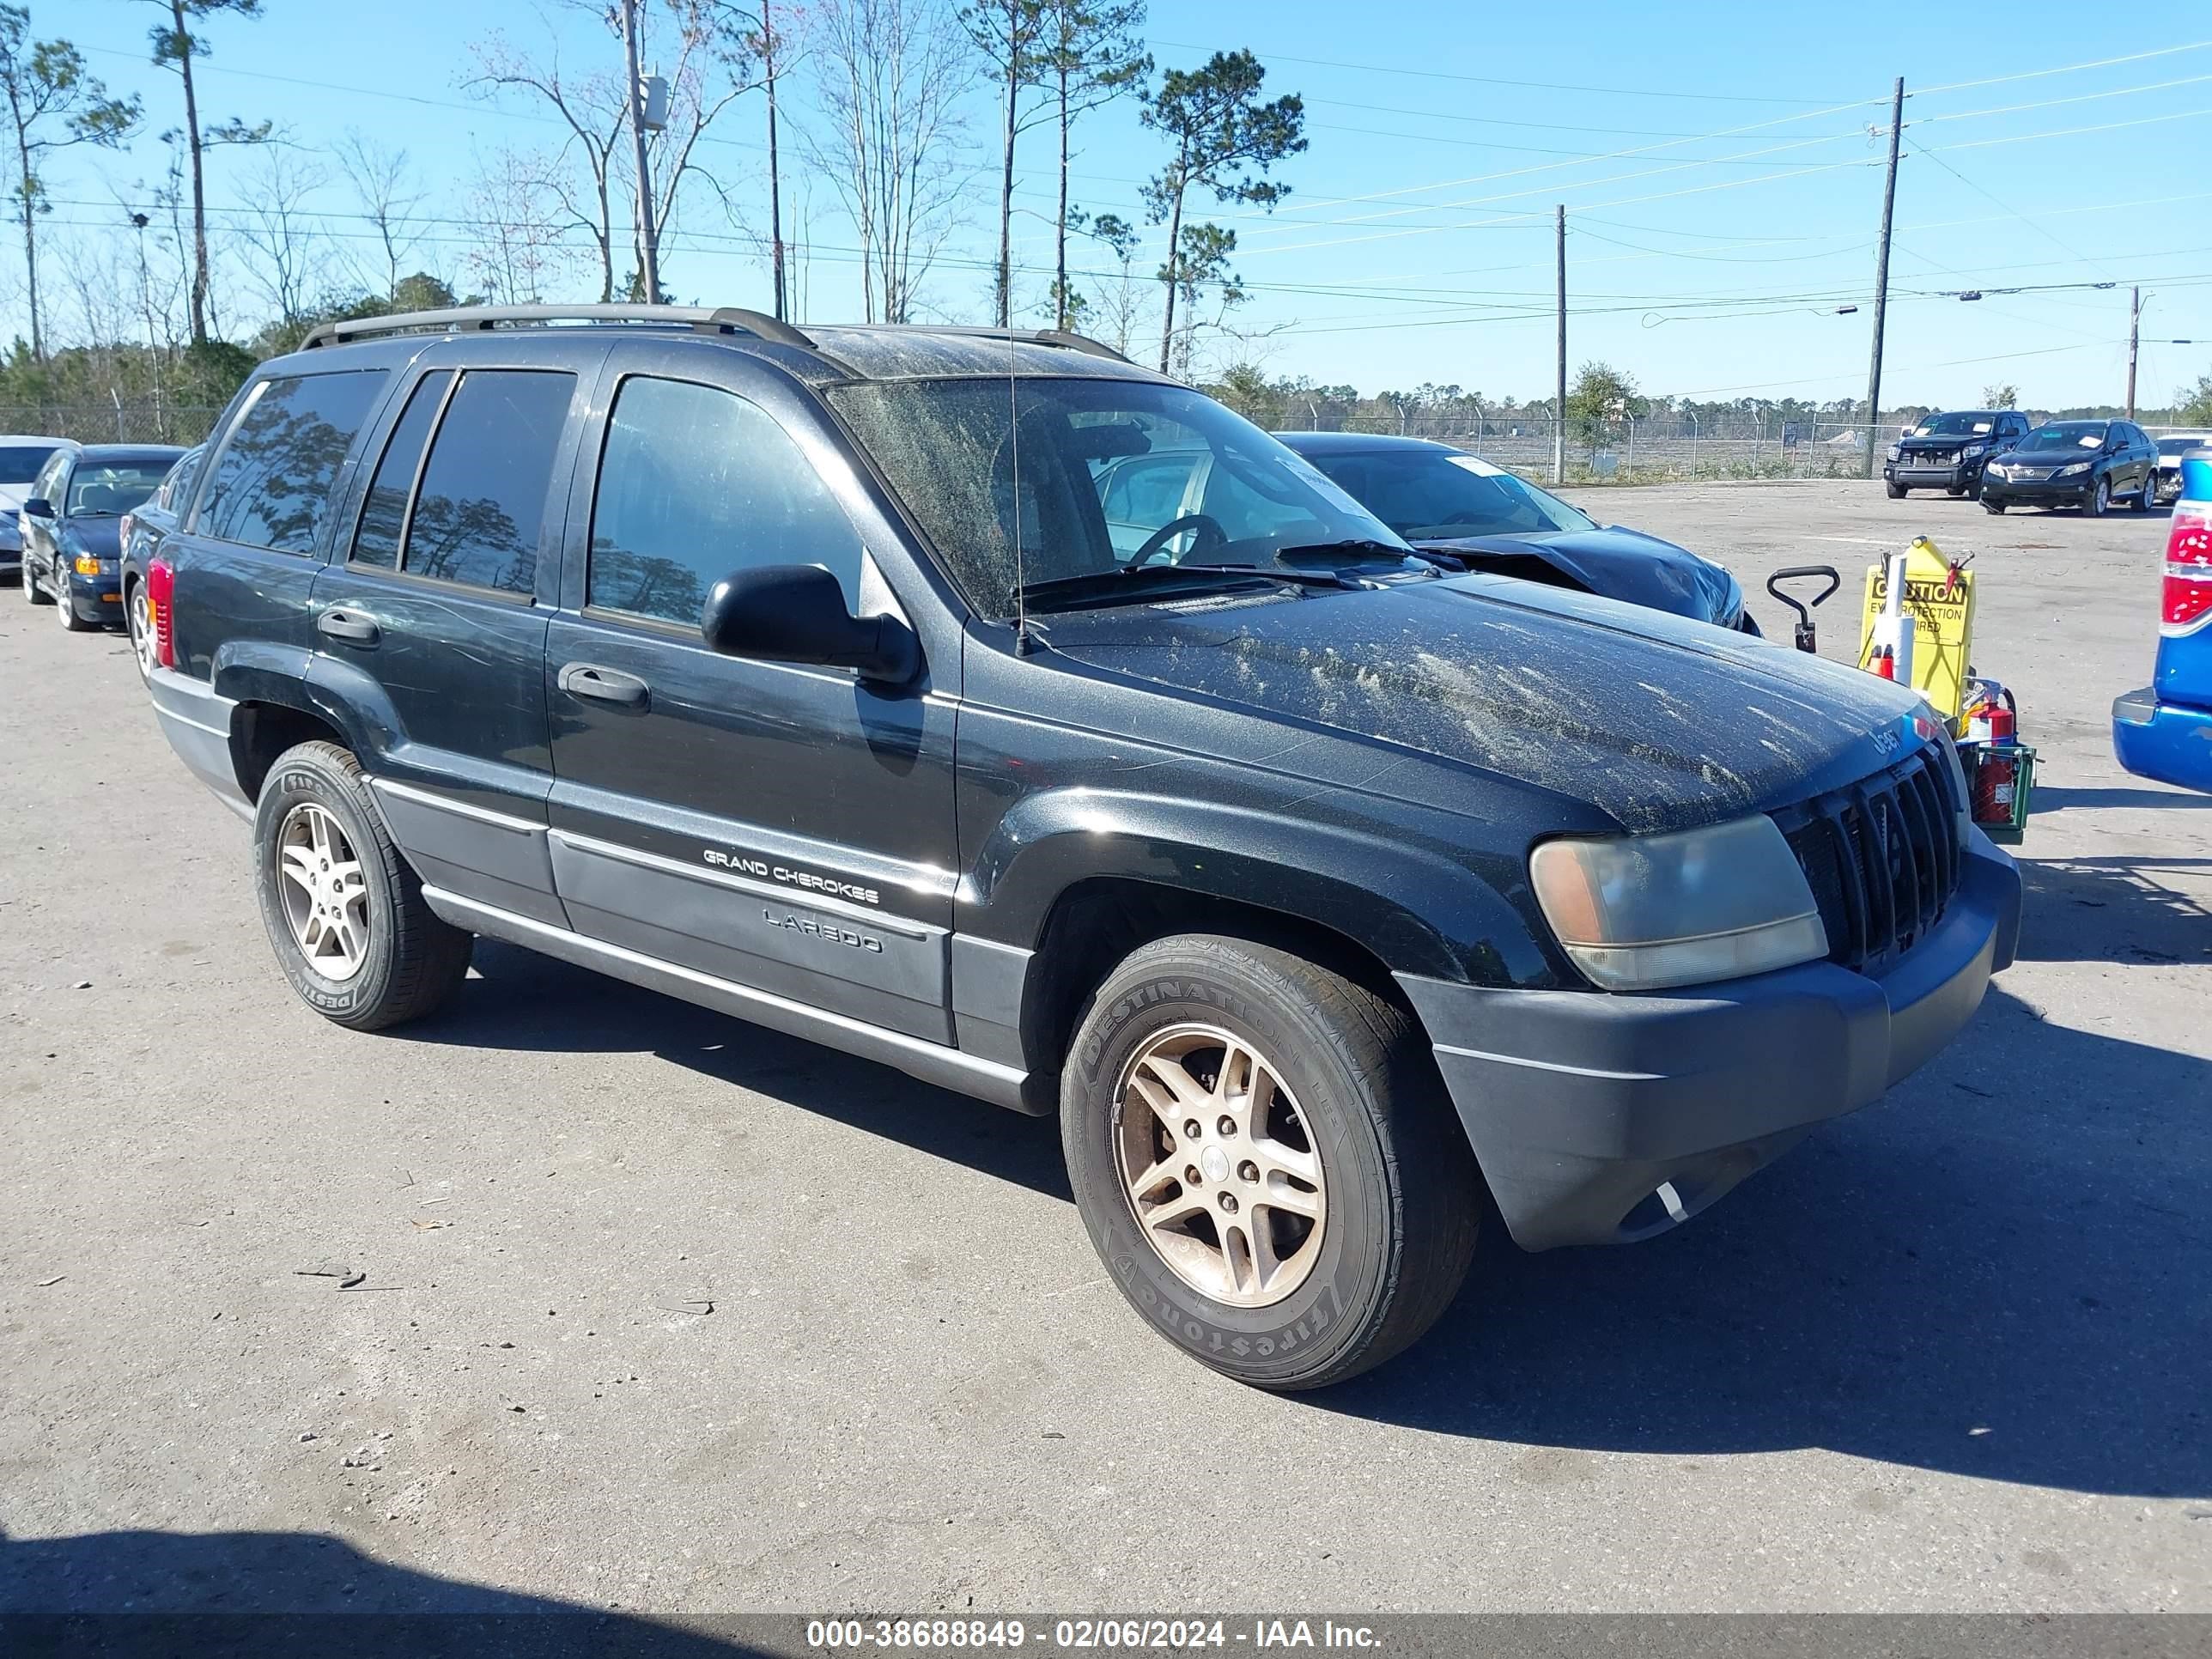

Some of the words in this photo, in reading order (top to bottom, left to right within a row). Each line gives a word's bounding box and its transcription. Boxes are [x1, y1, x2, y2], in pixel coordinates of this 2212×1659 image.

[1875, 580, 1963, 603] CUTION
[1902, 605, 1962, 620] ROTECTION
[703, 849, 769, 876] GRAND
[773, 866, 879, 903] CHEROKEE
[762, 908, 884, 953] LAREDO
[1140, 1283, 1329, 1358] Firestone
